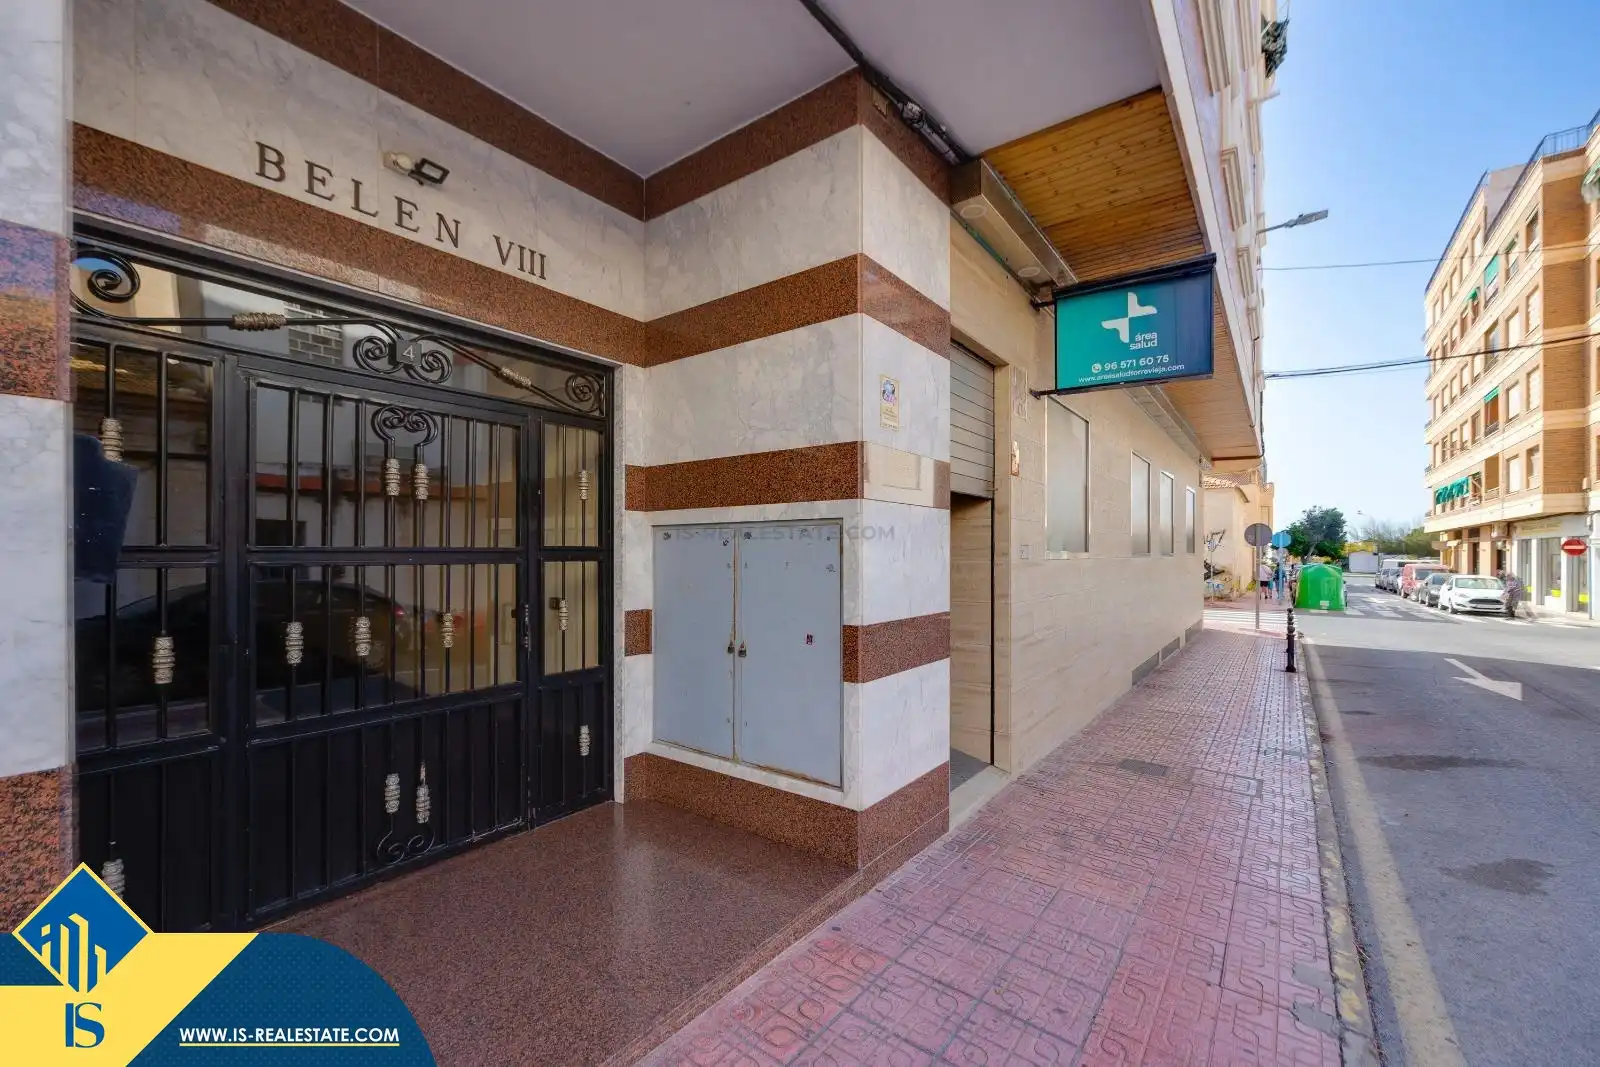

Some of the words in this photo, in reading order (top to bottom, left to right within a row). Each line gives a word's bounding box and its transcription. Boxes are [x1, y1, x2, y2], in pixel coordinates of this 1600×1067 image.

[255, 141, 461, 249] BELEN
[492, 234, 548, 281] VIII
[1135, 331, 1158, 342] área
[402, 344, 416, 360] 4
[1129, 340, 1158, 350] salud
[1104, 361, 1118, 371] 96
[1120, 358, 1137, 368] 571
[1139, 357, 1154, 366] 60
[1157, 354, 1169, 364] 75
